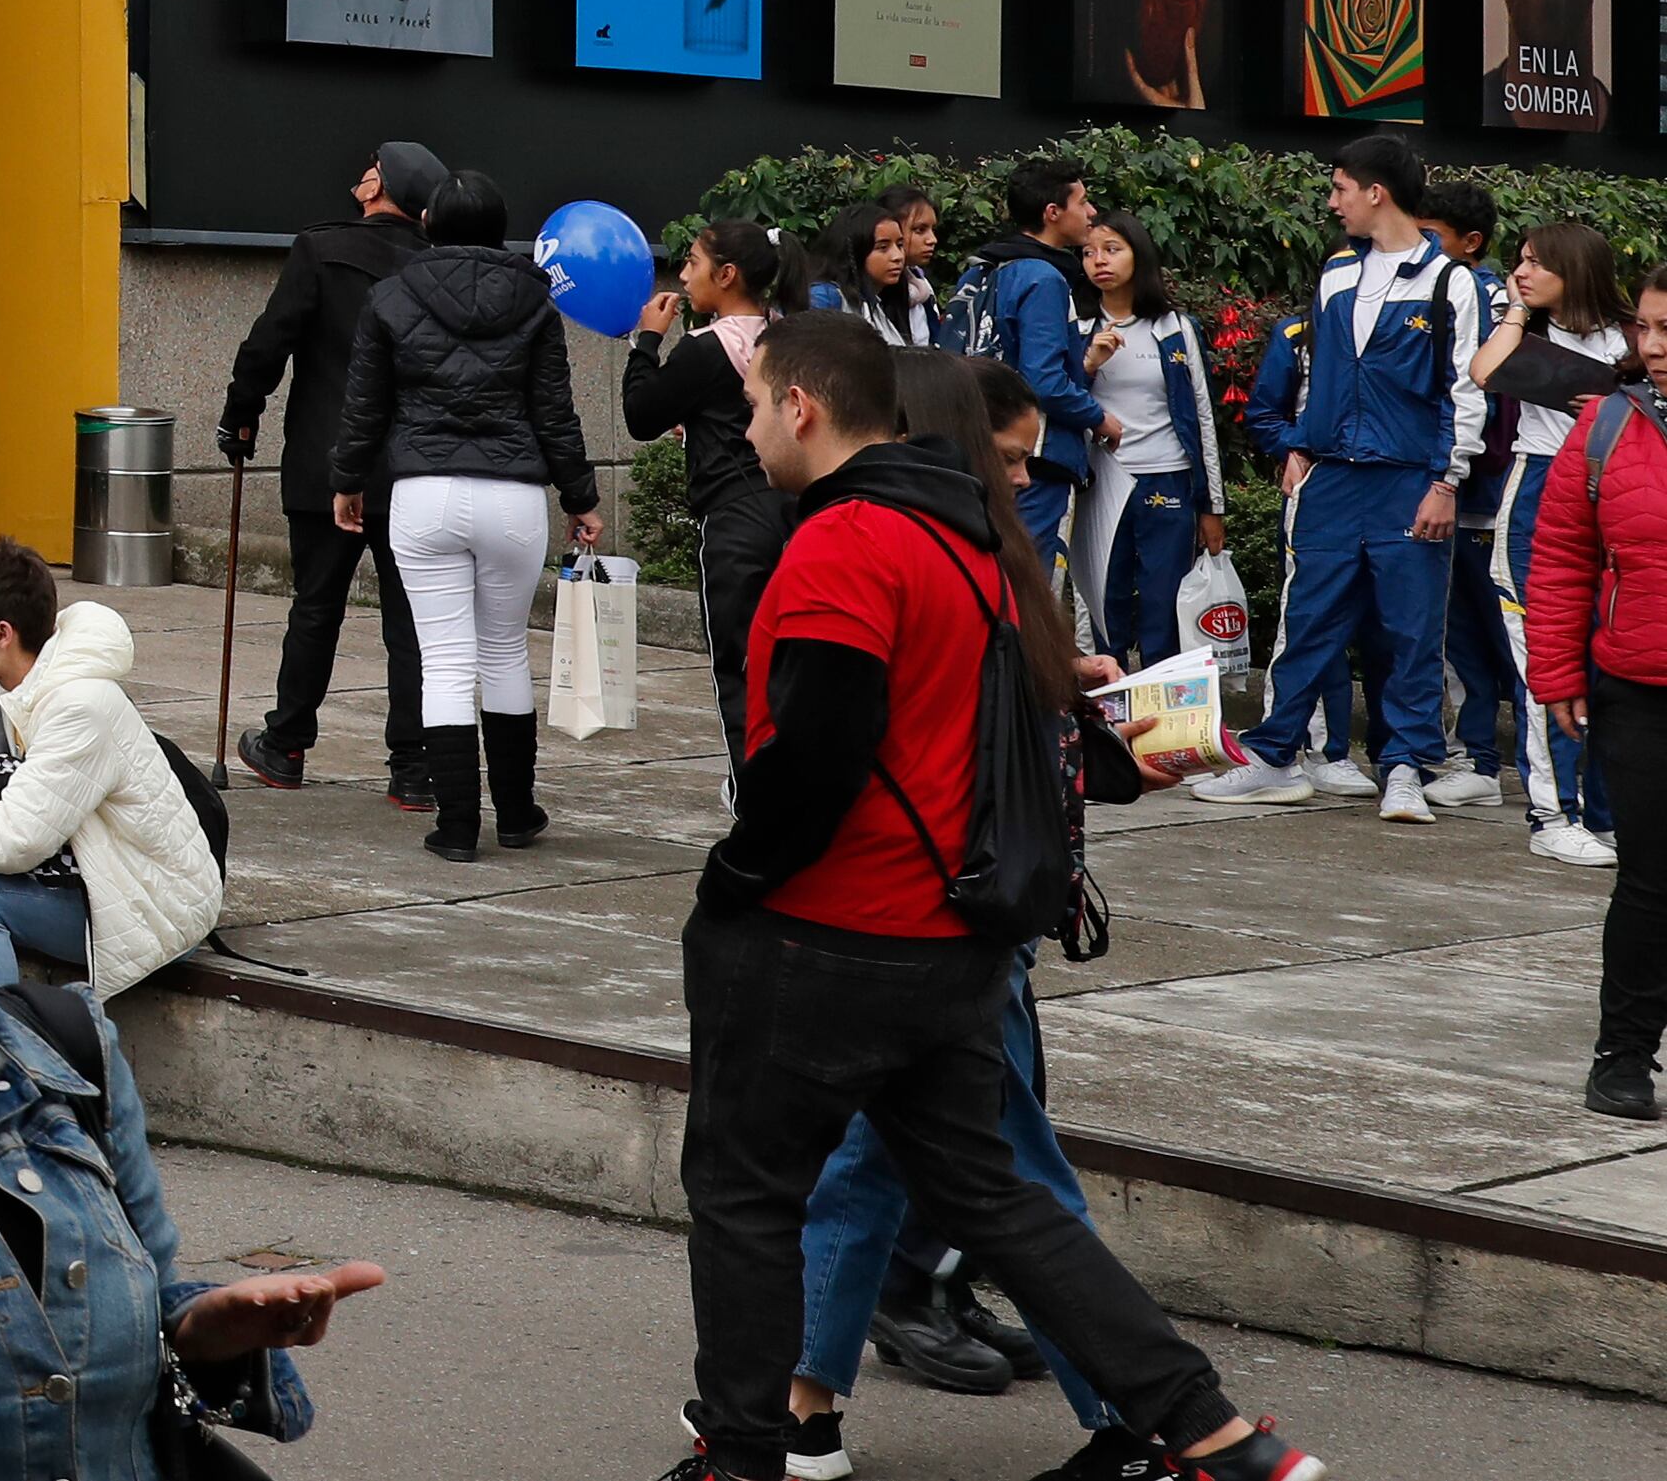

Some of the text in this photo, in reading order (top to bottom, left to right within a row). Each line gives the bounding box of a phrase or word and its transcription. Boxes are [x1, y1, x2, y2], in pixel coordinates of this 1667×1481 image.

[1519, 46, 1579, 77] EN LA
[1504, 84, 1593, 116] SOMBRA
